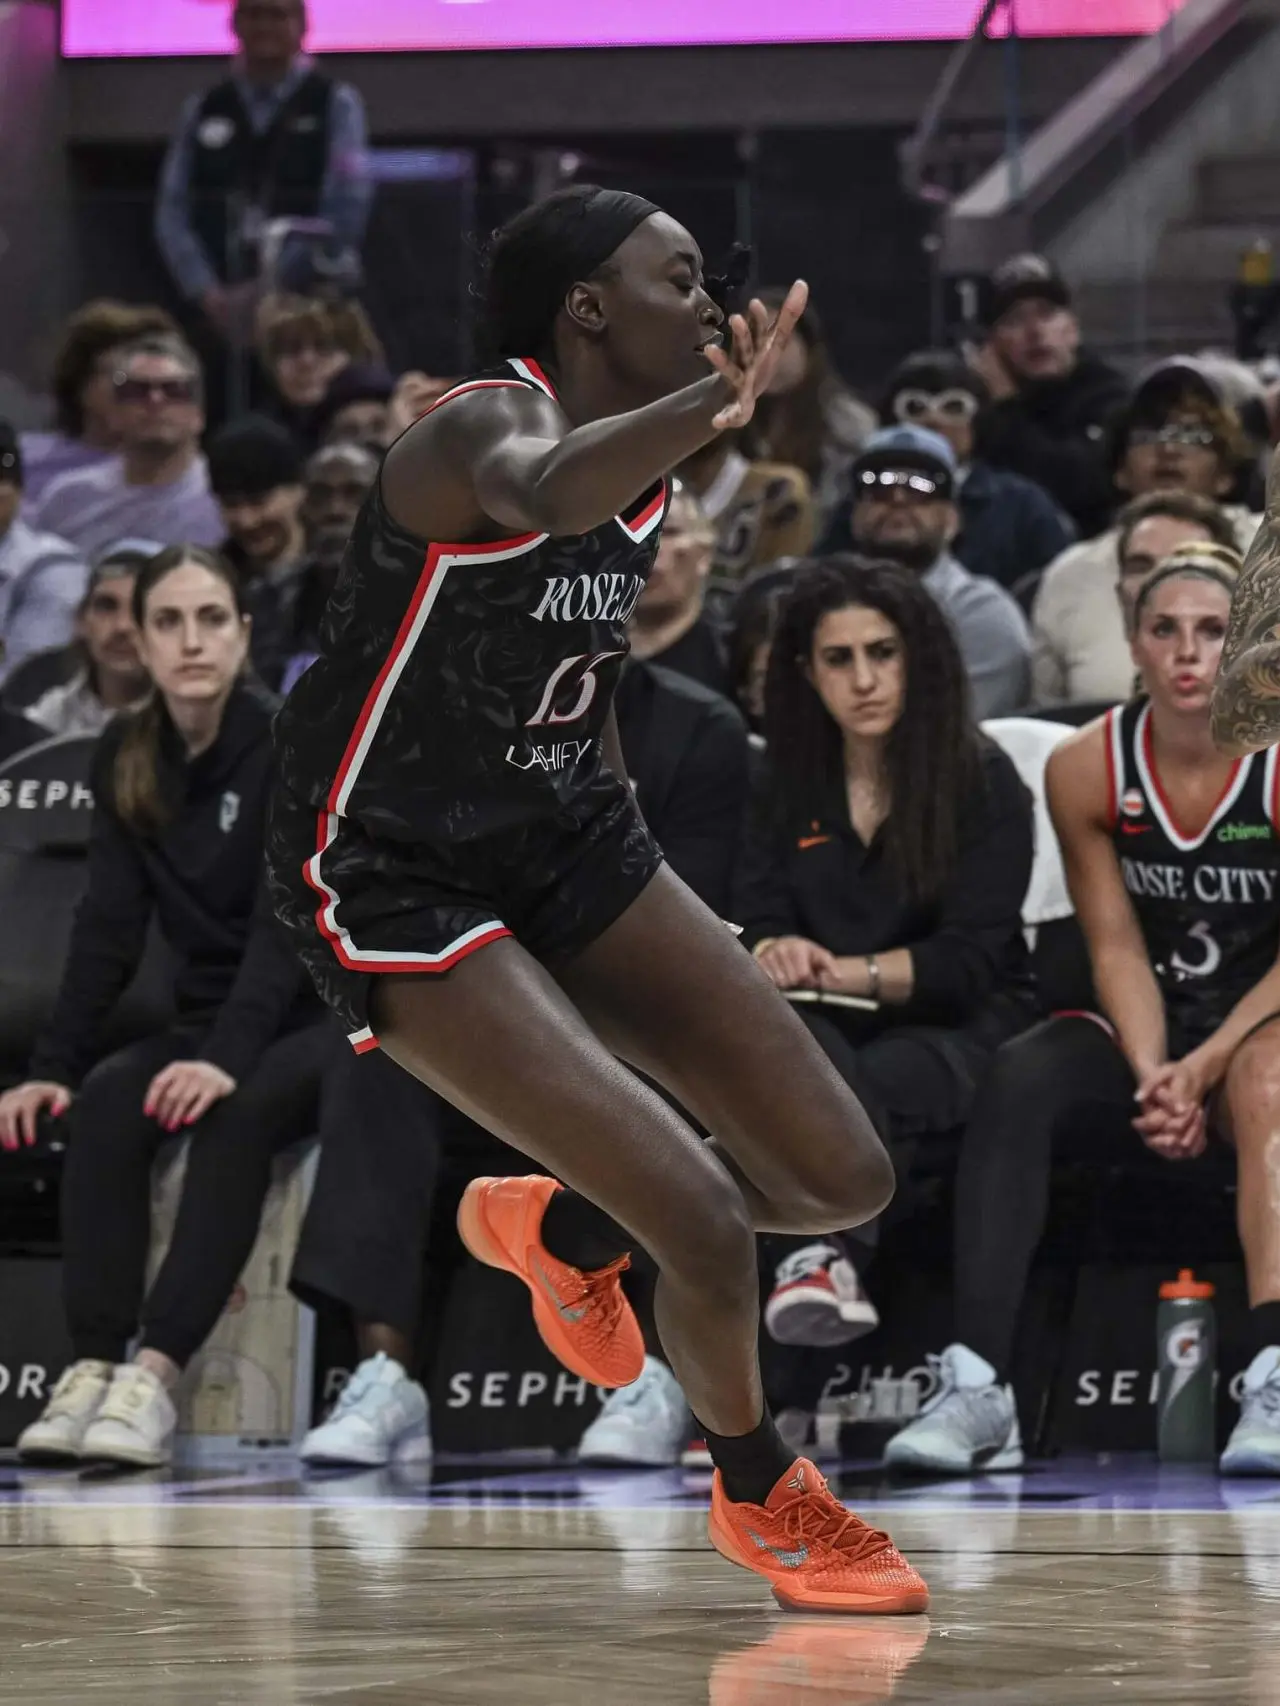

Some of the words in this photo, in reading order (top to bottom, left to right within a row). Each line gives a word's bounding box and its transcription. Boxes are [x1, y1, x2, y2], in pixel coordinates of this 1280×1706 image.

[528, 573, 625, 623] ROSE
[505, 739, 593, 772] LASHIFY
[1216, 820, 1271, 843] chime
[1193, 864, 1279, 903] CITY
